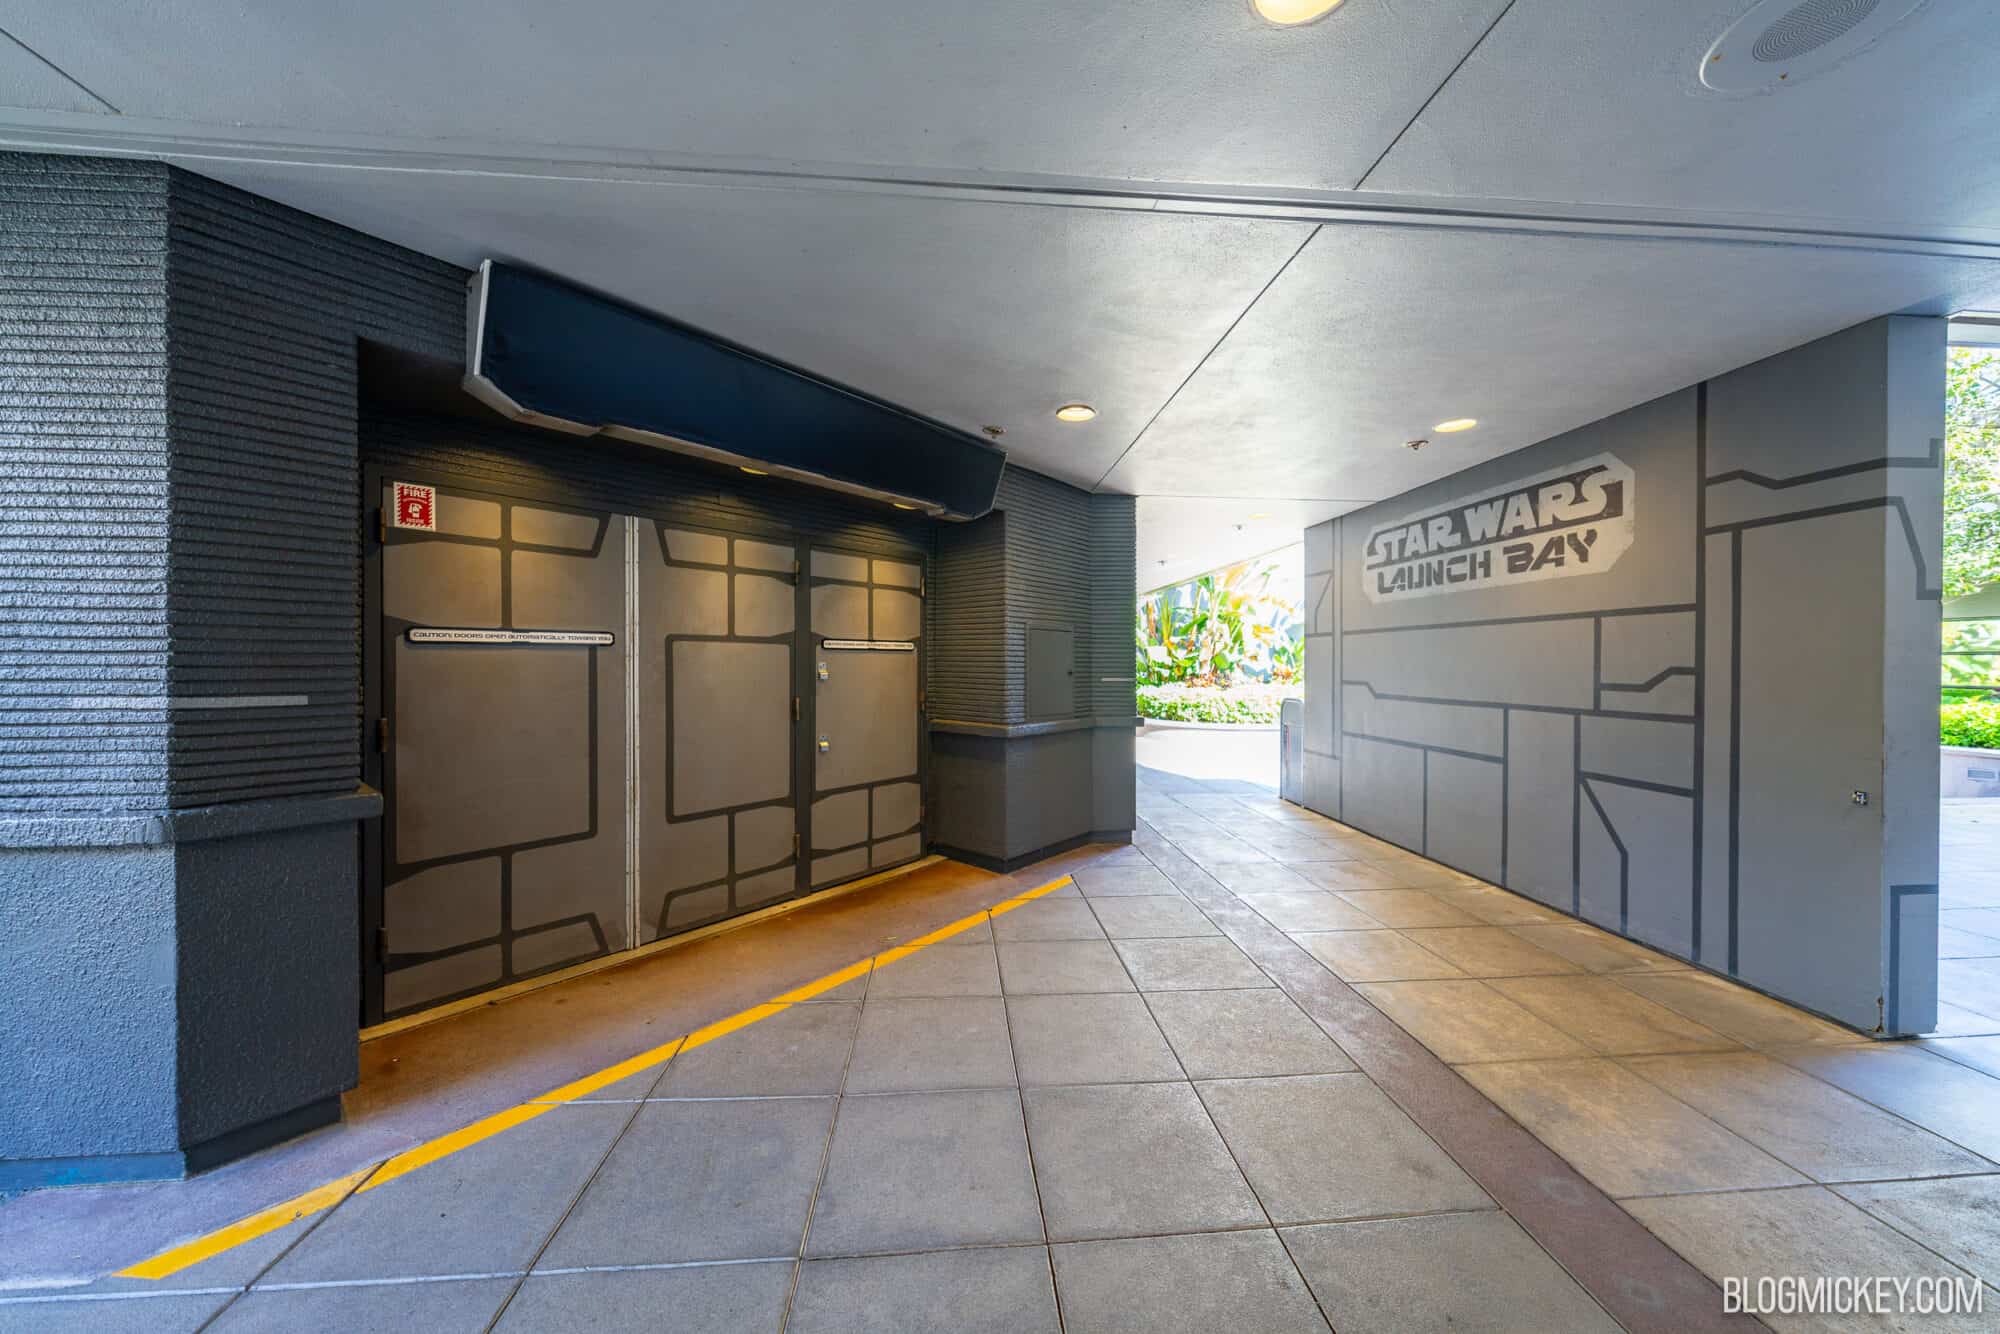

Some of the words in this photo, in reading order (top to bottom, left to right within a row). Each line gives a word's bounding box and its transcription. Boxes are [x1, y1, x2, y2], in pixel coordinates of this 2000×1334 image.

[403, 487, 427, 499] FIRE
[1373, 514, 1462, 563] STAR
[1464, 469, 1624, 542] WARS
[1376, 549, 1492, 595] LAUNCH
[1503, 527, 1599, 575] BAY
